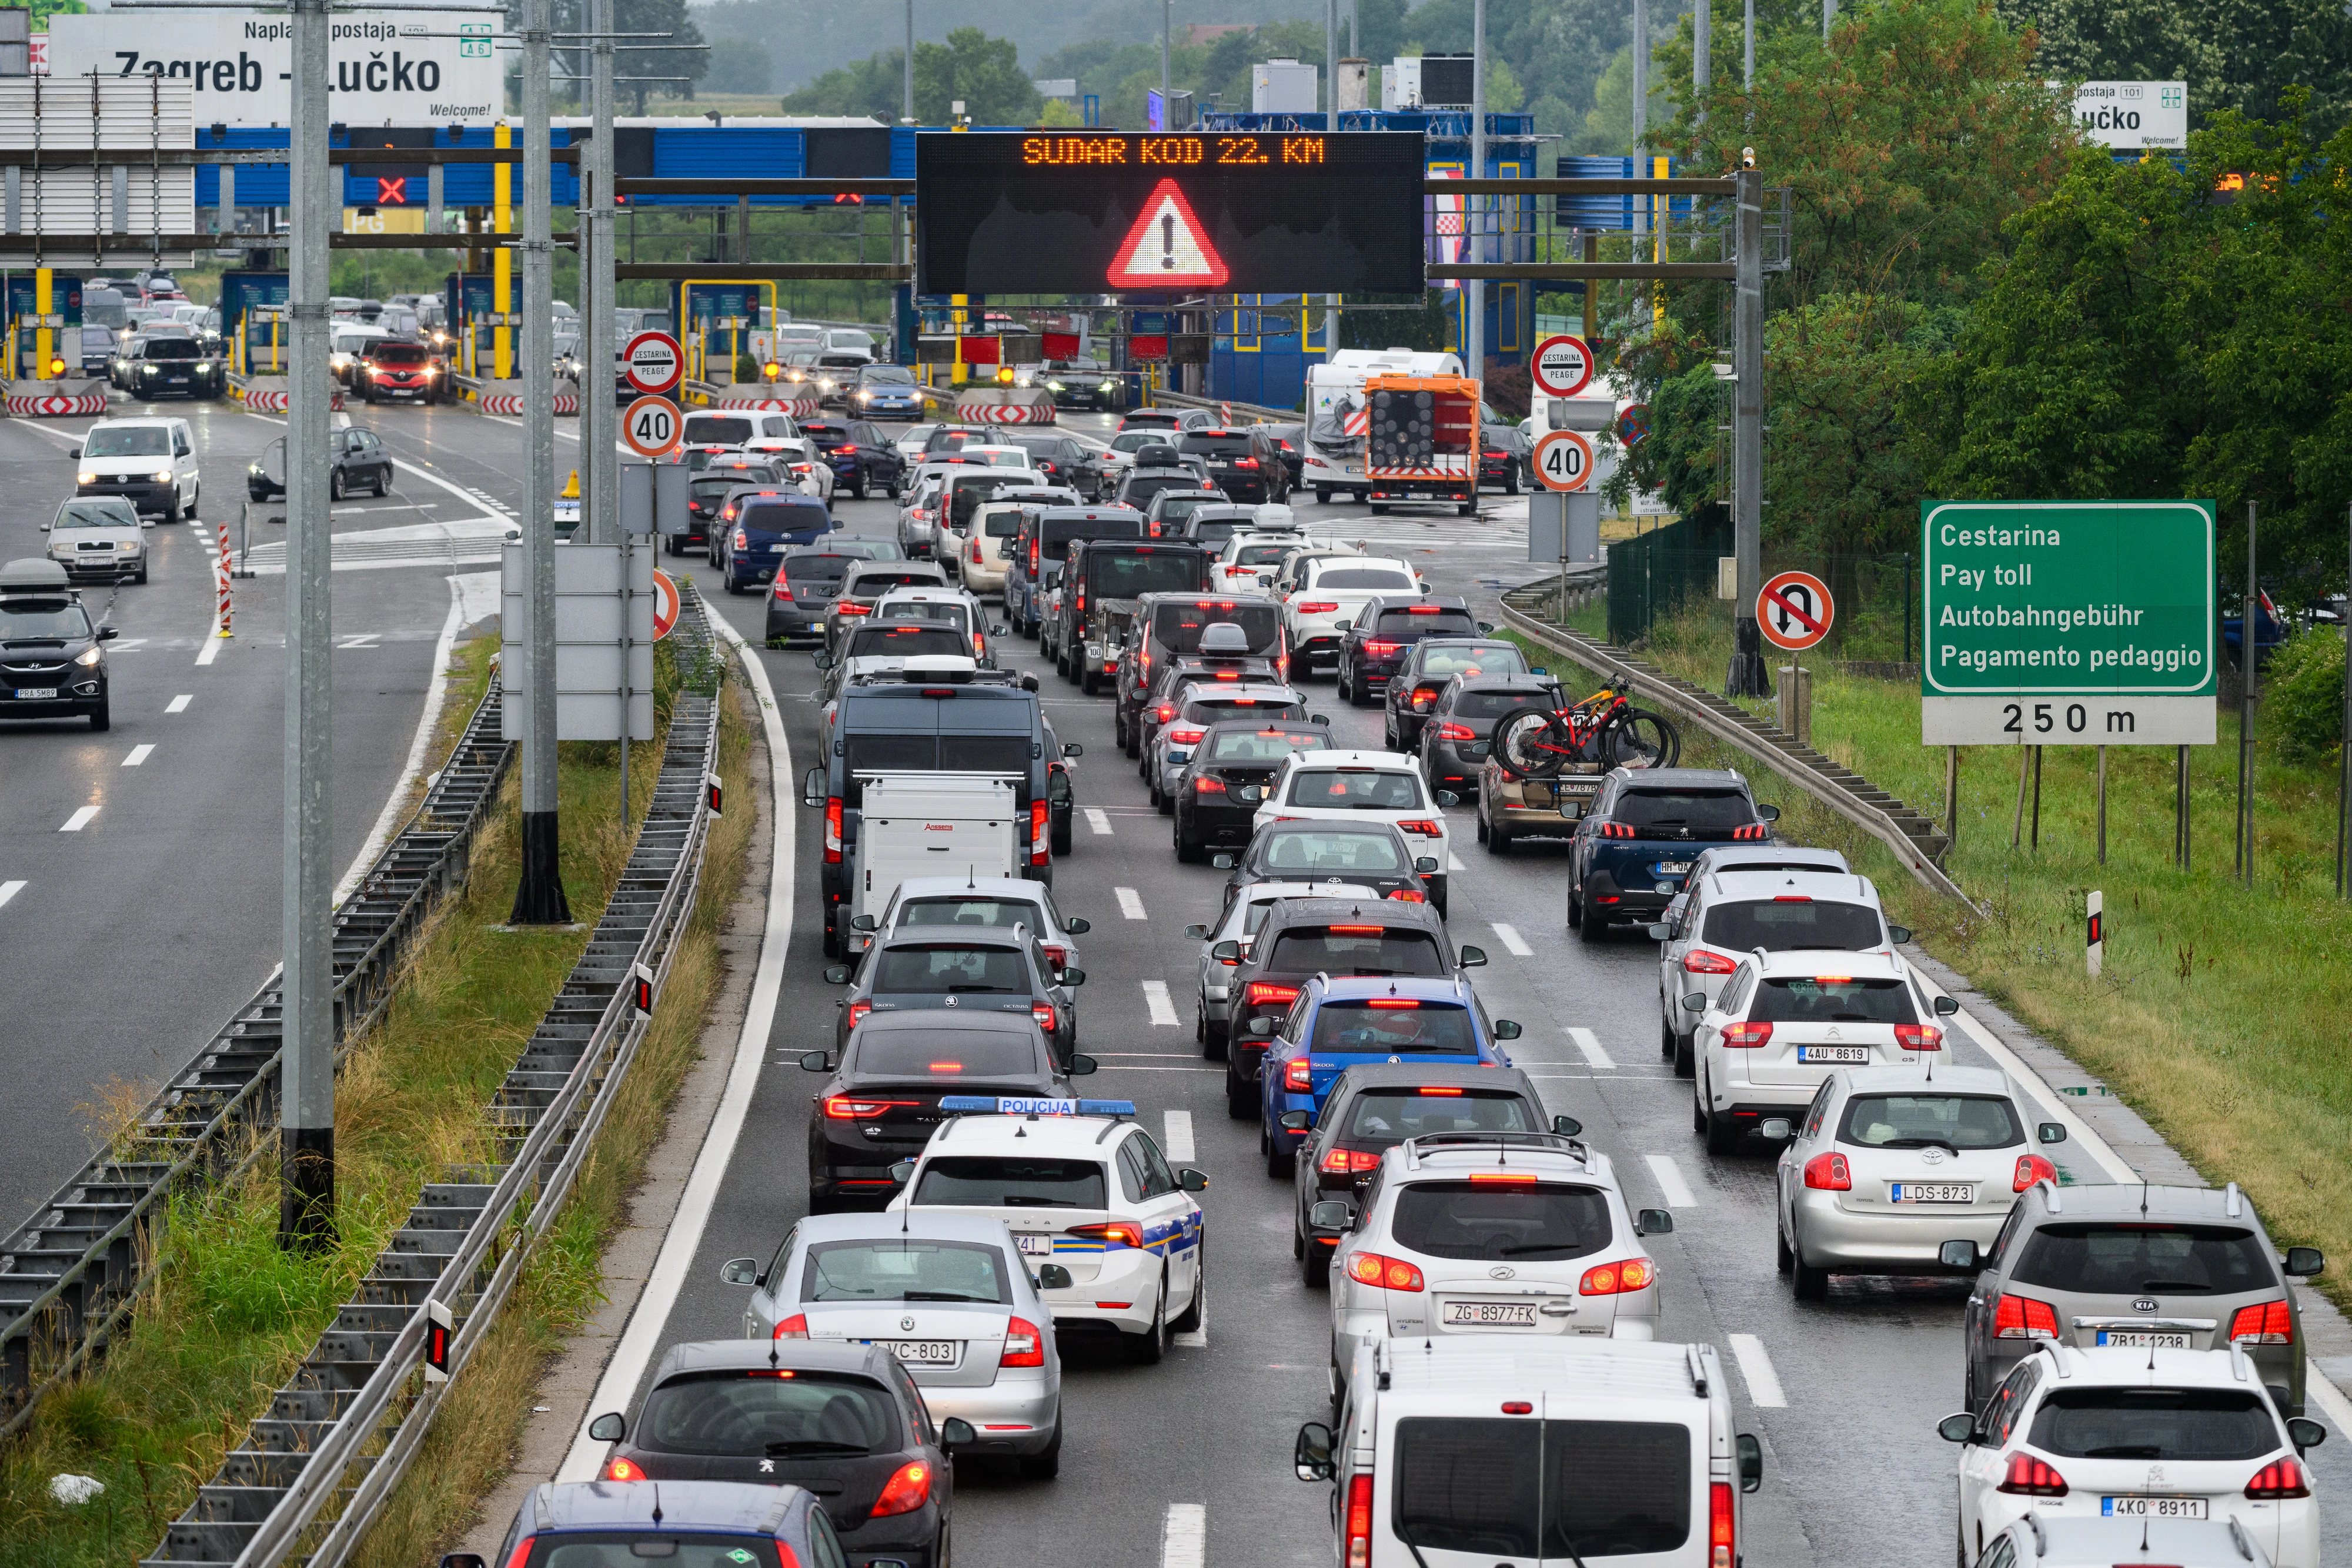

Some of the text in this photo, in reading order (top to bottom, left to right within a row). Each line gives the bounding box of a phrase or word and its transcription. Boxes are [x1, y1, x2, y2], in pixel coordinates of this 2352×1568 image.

[246, 22, 396, 41] Napla postaja
[329, 51, 440, 92] učko
[2124, 88, 2140, 97] 101
[430, 103, 490, 117] Welcome!
[2141, 136, 2179, 145] Welcome!
[1024, 138, 1324, 163] SUDAR KOD 22. KM
[636, 413, 669, 440] 40
[1546, 447, 1580, 476] 40
[1940, 524, 2060, 547] Cestarina
[1941, 563, 2031, 591] Pay toll
[1939, 604, 2144, 632] Autobahngebühr
[1090, 648, 1101, 656] 100
[1941, 644, 2201, 672] Pagamento pedaggio
[2106, 711, 2134, 733] m
[1662, 862, 1672, 872] HH
[1808, 1048, 1863, 1059] 4AU 8619
[1003, 1100, 1071, 1114] POLICIJA
[1904, 1186, 1969, 1200] LDS-873
[1455, 1306, 1471, 1319] ZG
[2135, 1302, 2155, 1310] KIA
[875, 1343, 949, 1359] VC-803
[2159, 1501, 2198, 1516] 8911
